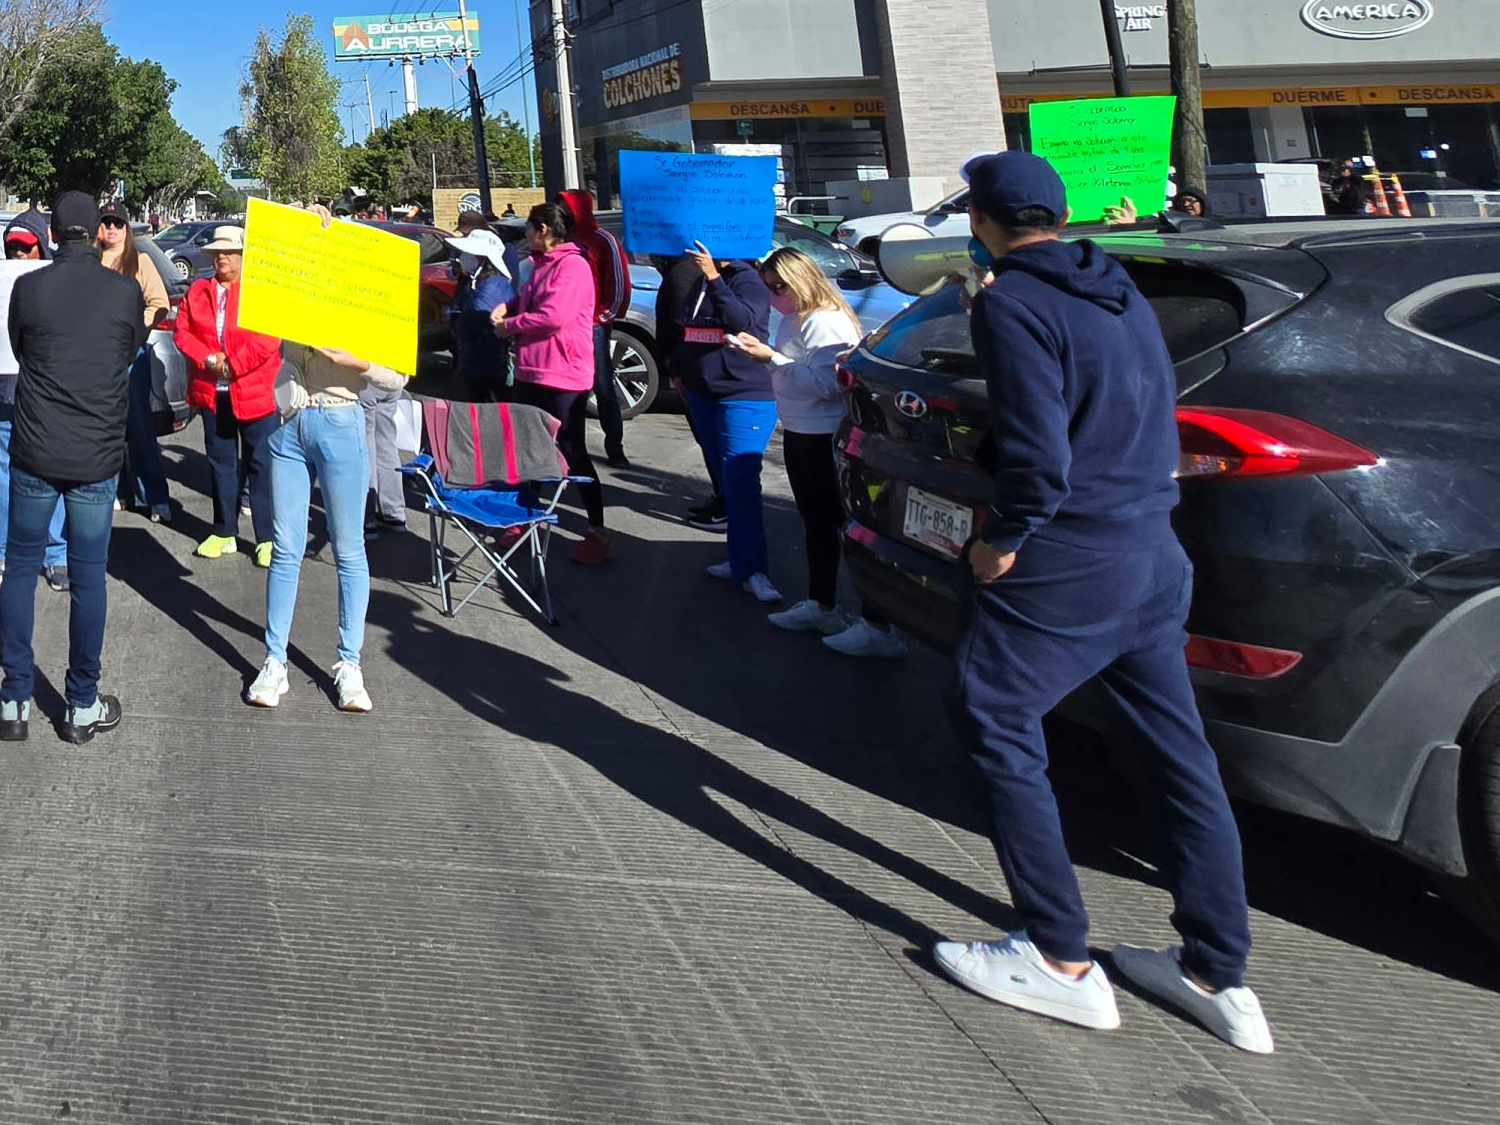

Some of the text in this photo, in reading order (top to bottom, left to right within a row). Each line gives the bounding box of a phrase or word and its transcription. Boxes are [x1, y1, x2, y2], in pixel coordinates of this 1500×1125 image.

[1114, 5, 1165, 18] SPRING
[1316, 3, 1420, 20] AMERICA
[367, 22, 449, 35] BODEGA
[1126, 17, 1153, 30] AIR
[603, 59, 681, 109] COLCHONES
[1272, 87, 1495, 103] DUERME DESCANSA
[730, 101, 811, 116] DESCANSA
[673, 155, 736, 169] Gobernador
[663, 168, 698, 181] Sergio
